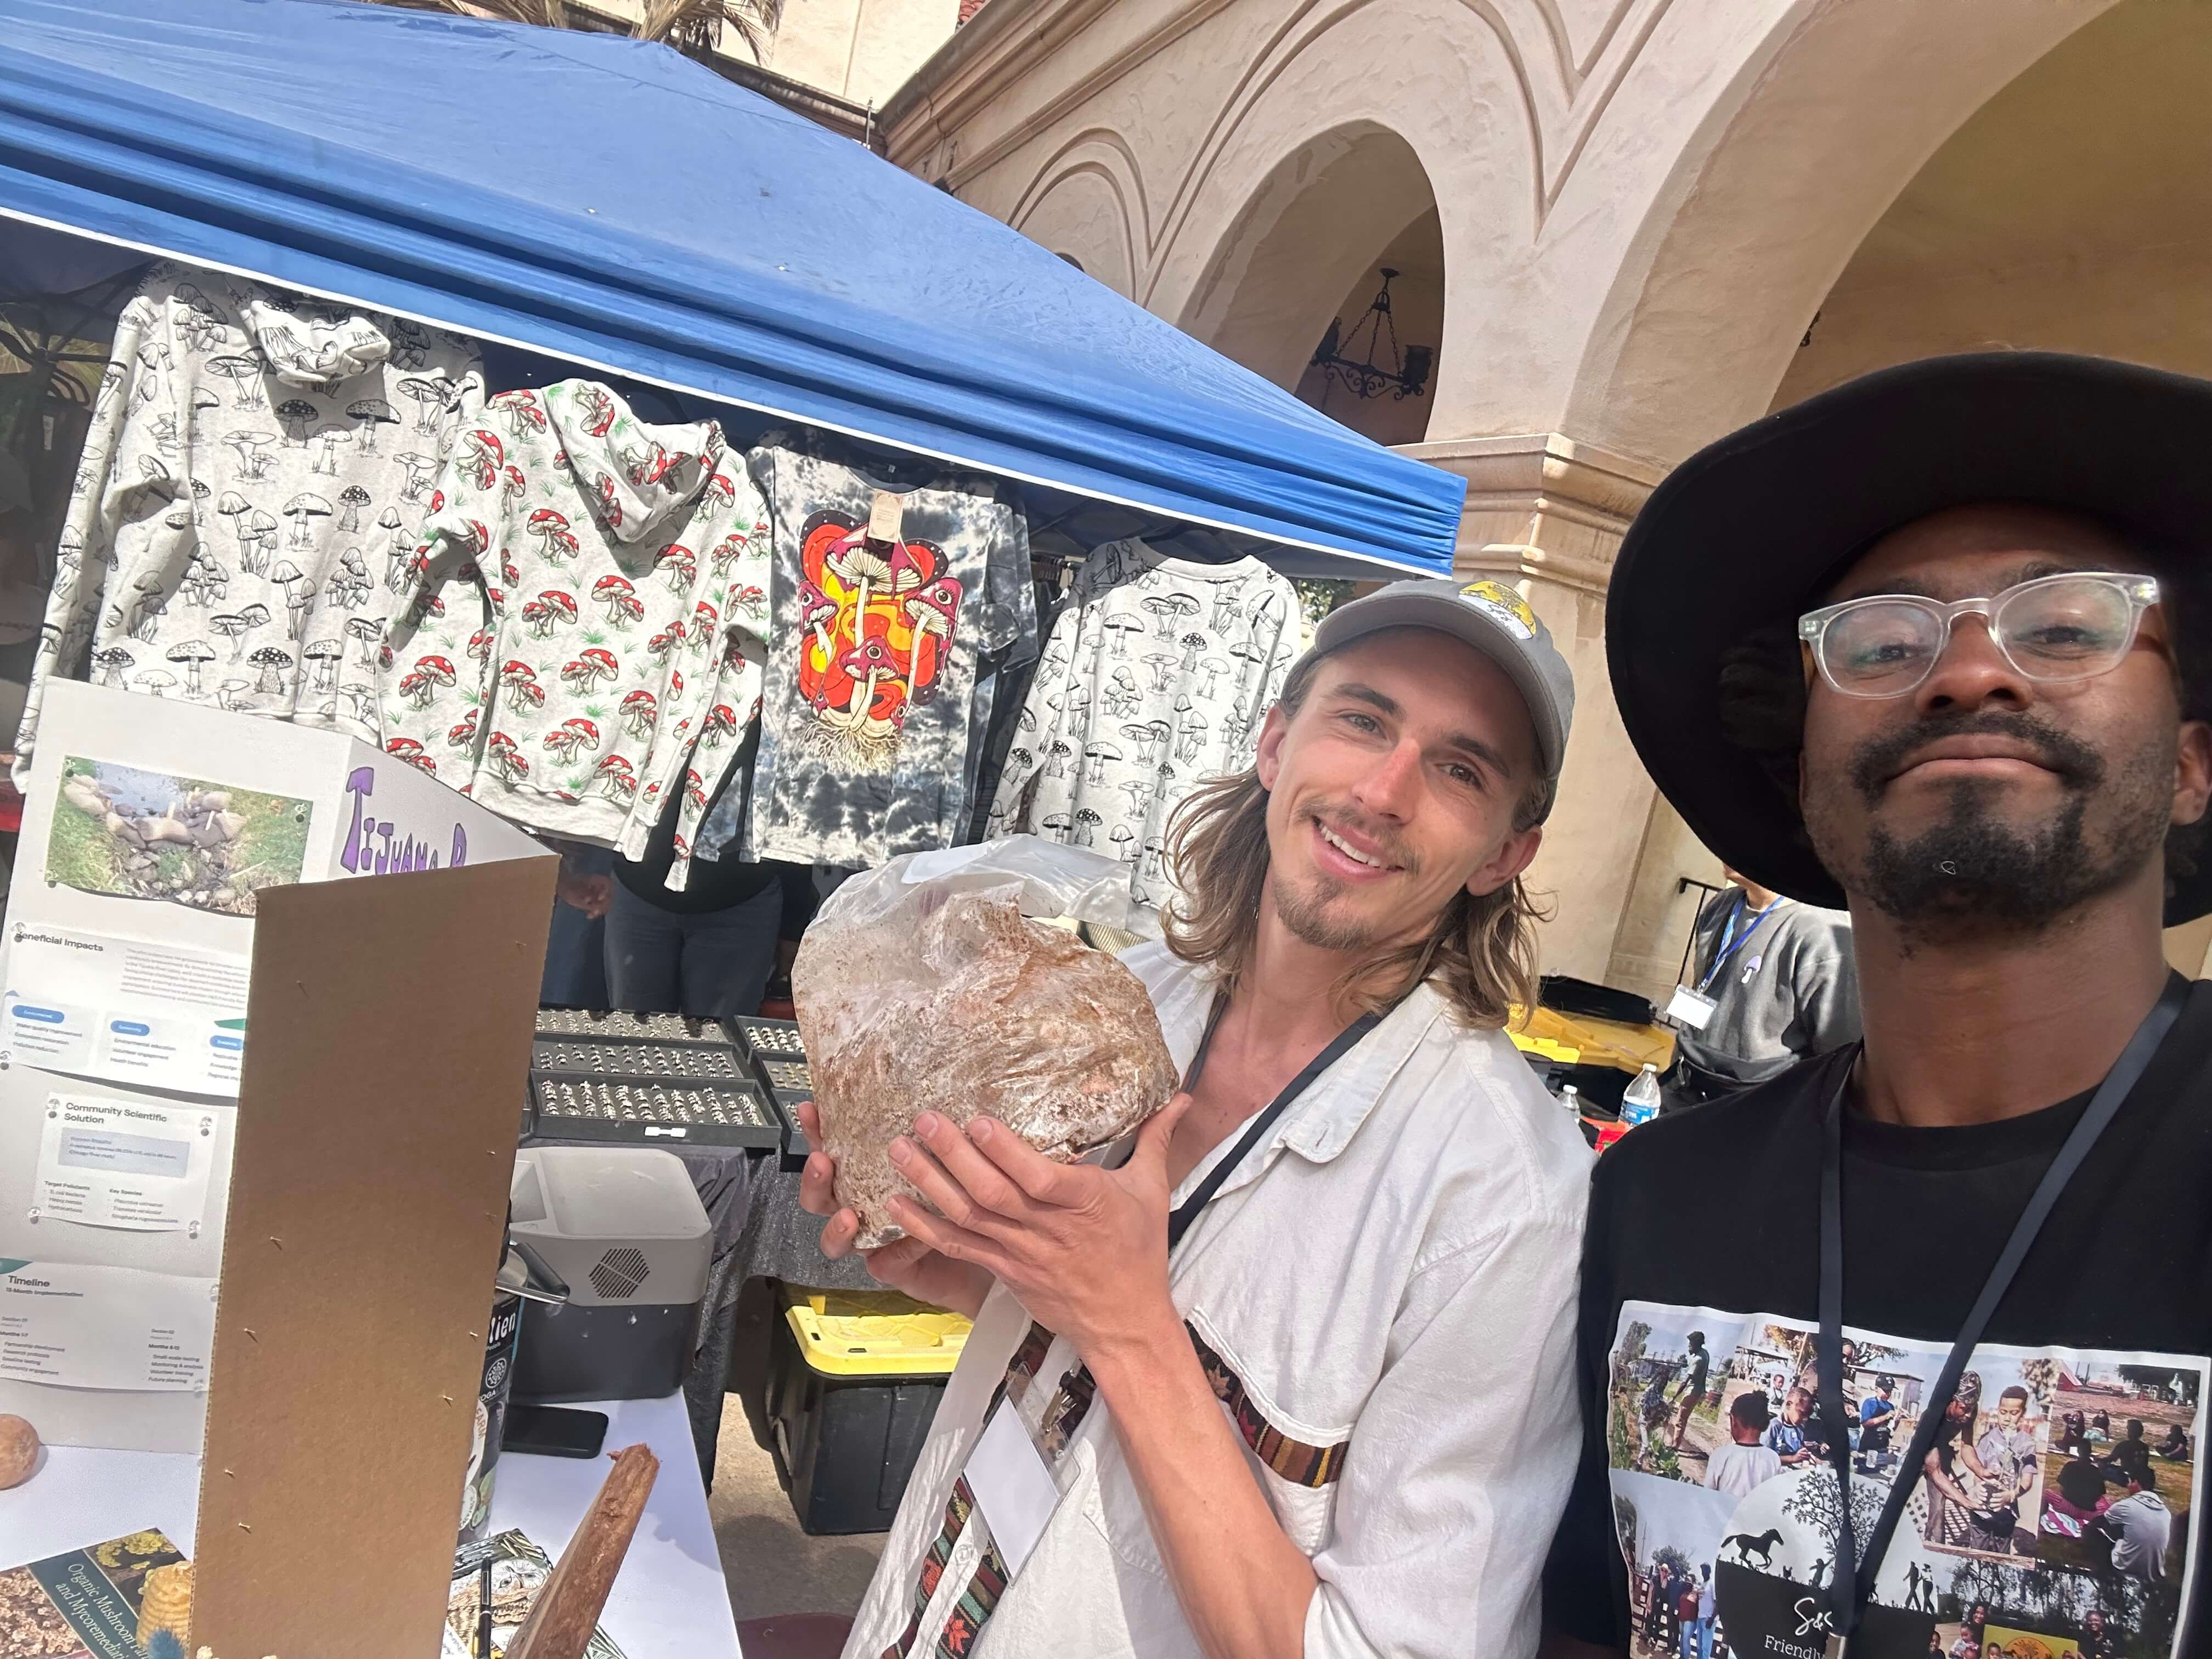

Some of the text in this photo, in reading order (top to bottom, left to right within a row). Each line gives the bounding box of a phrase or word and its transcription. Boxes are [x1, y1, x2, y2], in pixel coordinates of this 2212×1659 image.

[64, 939, 103, 952] Impacts
[64, 1113, 104, 1124] Solution
[66, 1102, 167, 1122] Community Scientific
[8, 1276, 50, 1287] Timeline
[489, 1312, 516, 1344] lien
[479, 1390, 496, 1402] OGA
[67, 1563, 100, 1597] Organic
[93, 1595, 136, 1645] Mushroom
[55, 1583, 129, 1659] and Mycoremediati
